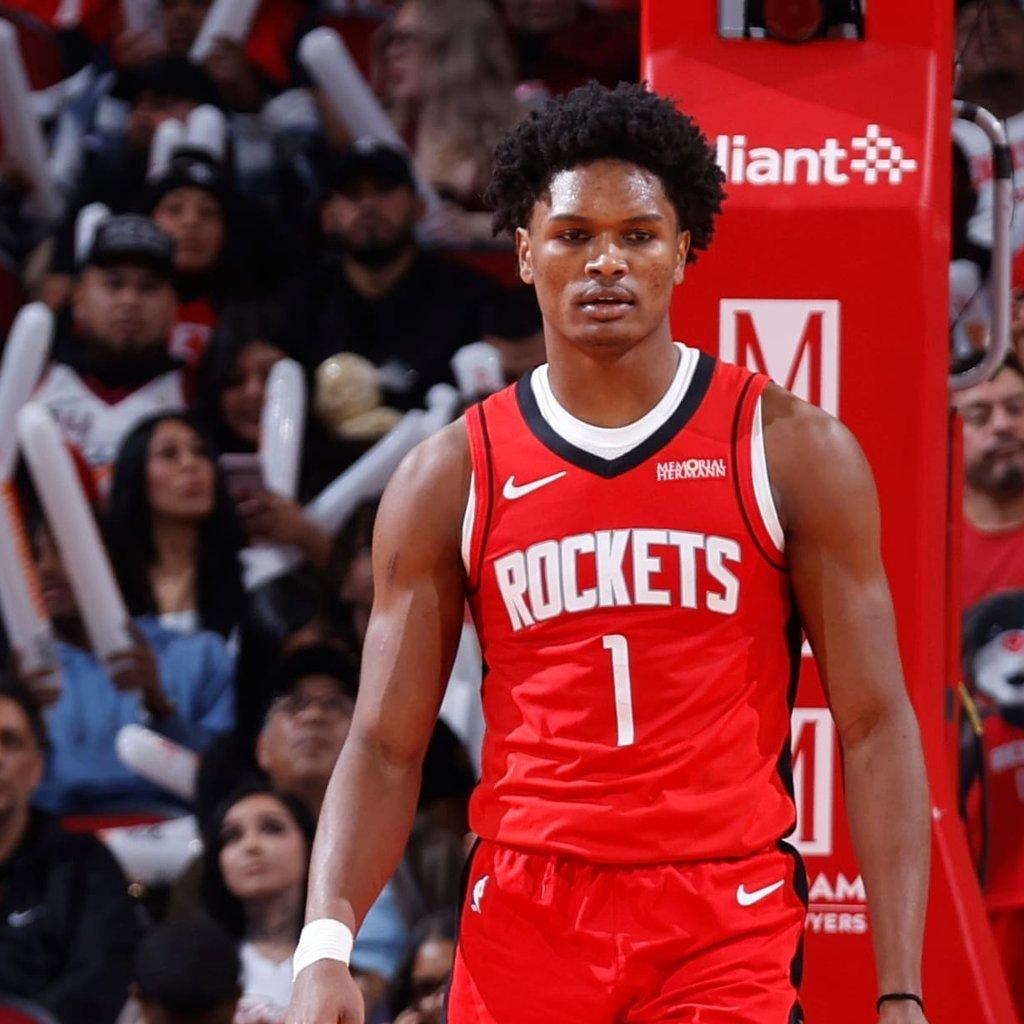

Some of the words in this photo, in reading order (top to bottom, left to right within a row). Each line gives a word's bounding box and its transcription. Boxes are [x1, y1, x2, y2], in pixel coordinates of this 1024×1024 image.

[657, 459, 725, 471] MEMORIAL
[657, 466, 725, 481] HERMANN
[493, 528, 741, 631] ROCKETS
[602, 634, 634, 746] 1
[806, 873, 867, 901] AM
[804, 913, 868, 934] YERS
